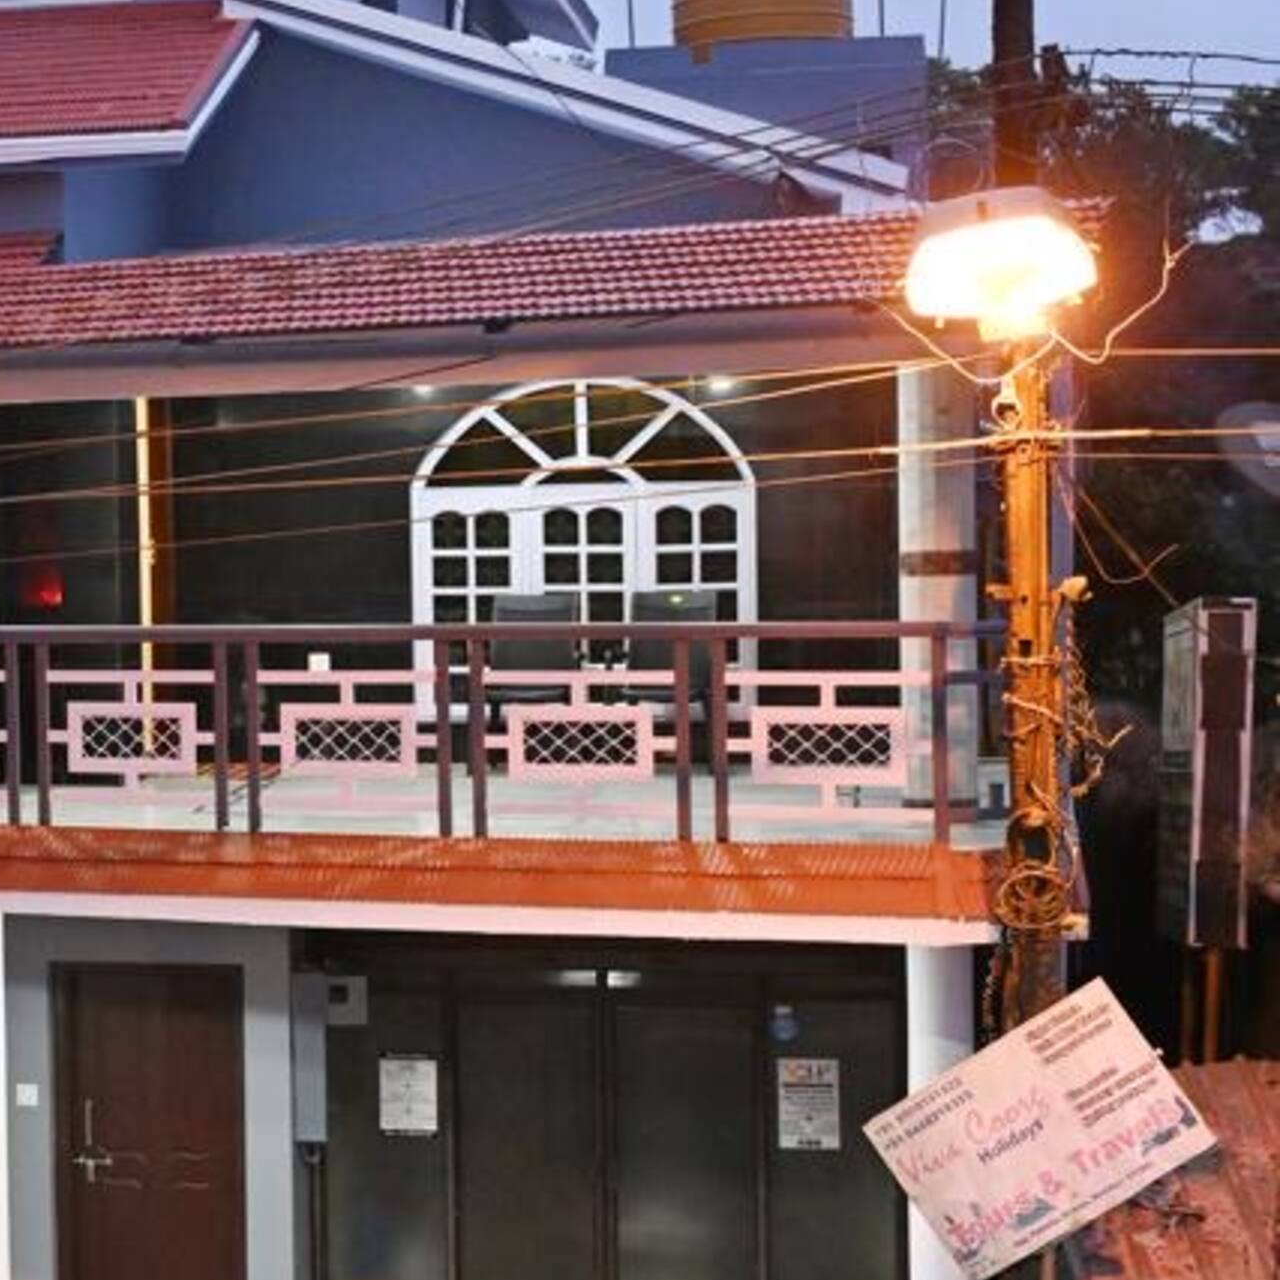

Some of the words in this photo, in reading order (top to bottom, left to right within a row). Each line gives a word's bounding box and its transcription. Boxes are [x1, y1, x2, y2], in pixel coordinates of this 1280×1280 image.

[964, 1086, 1049, 1145] Coorg
[976, 1119, 1045, 1166] Holidays
[1040, 1169, 1064, 1196] &
